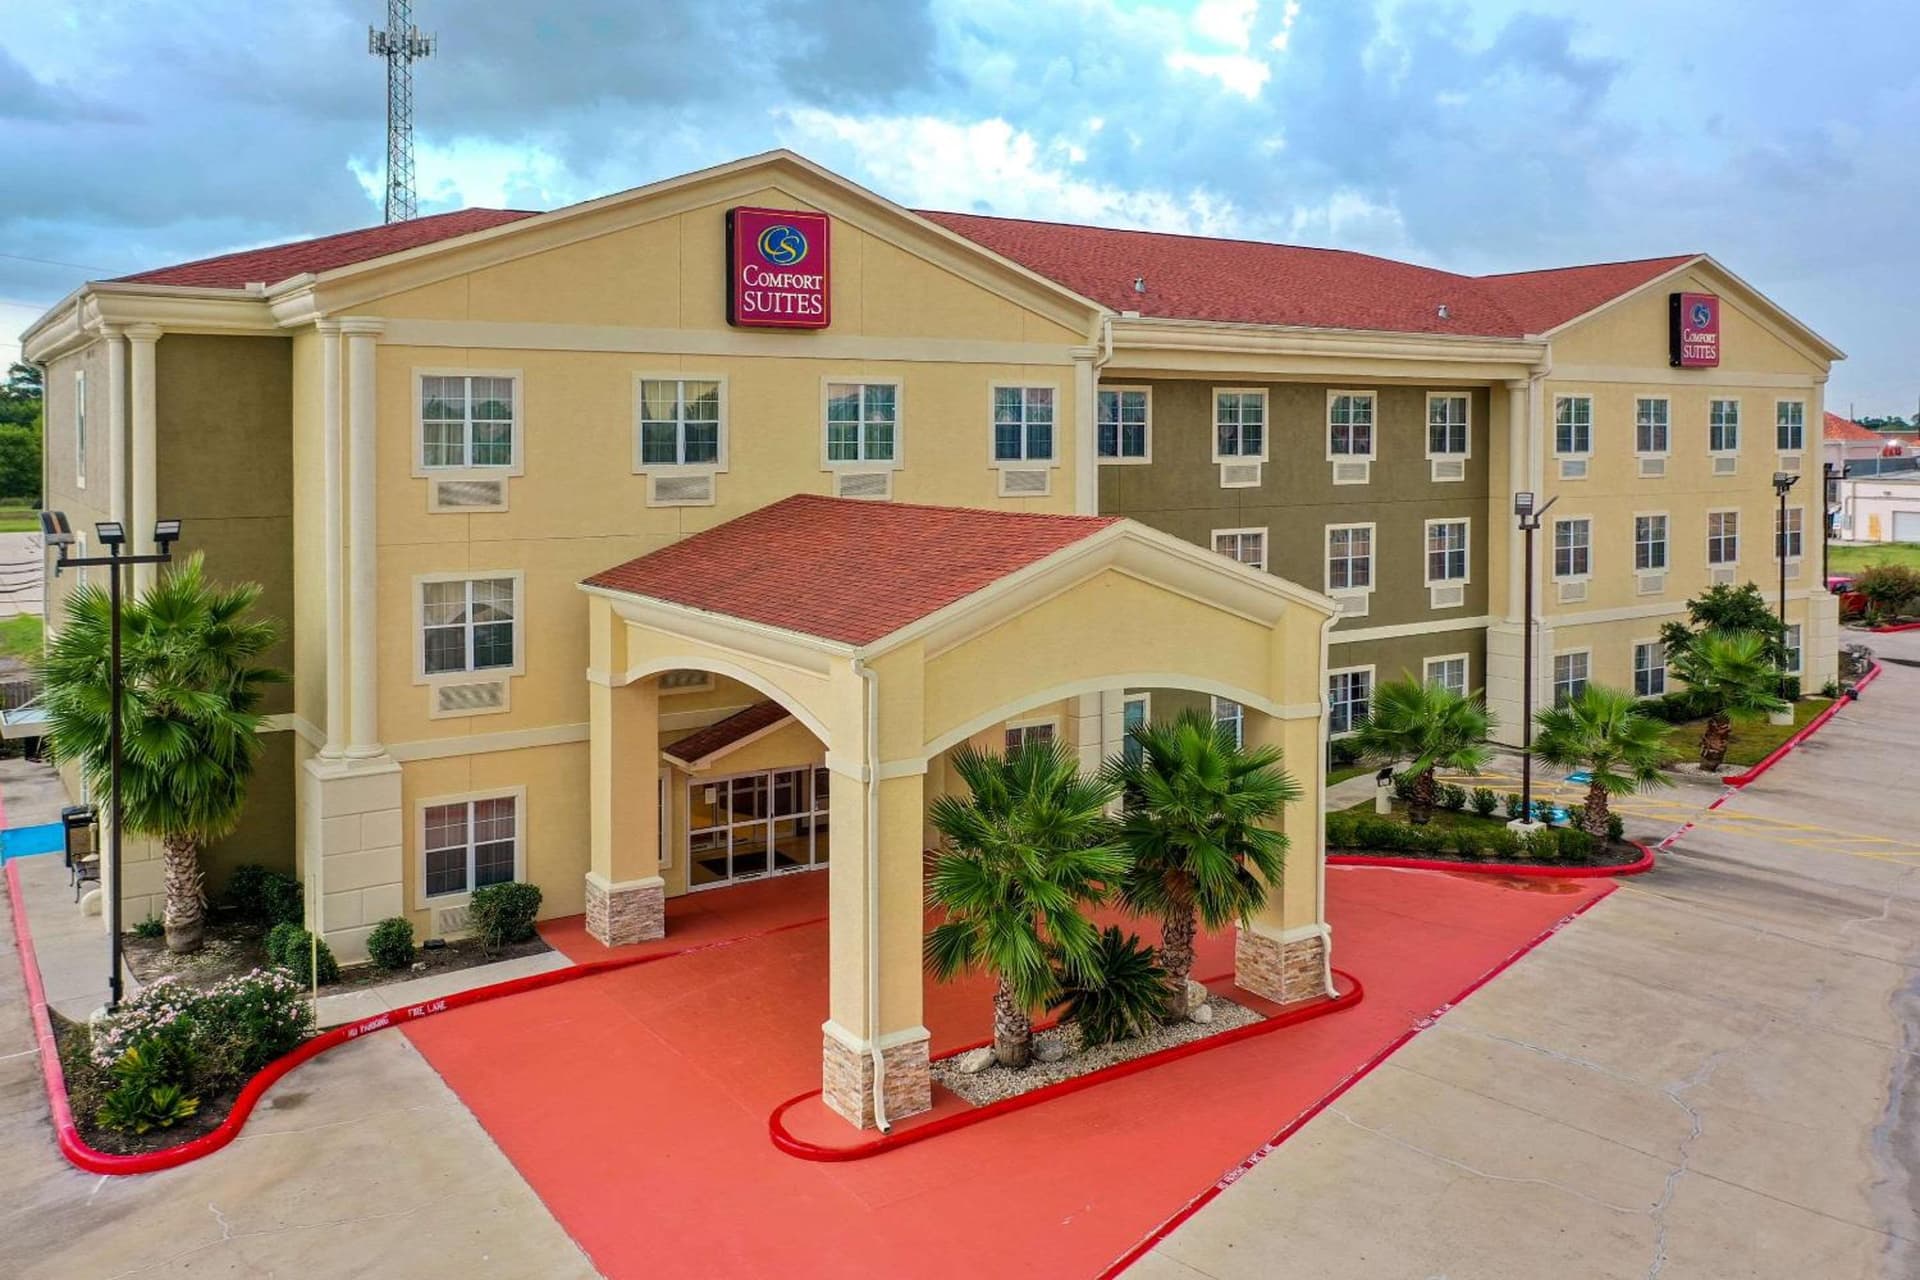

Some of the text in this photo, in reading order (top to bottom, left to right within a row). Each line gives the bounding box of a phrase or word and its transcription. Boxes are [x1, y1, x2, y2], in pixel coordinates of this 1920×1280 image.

[743, 264, 823, 289] COMFORT
[743, 291, 822, 314] SUITES
[1683, 328, 1716, 344] COMFORT
[1683, 345, 1716, 359] SUITES
